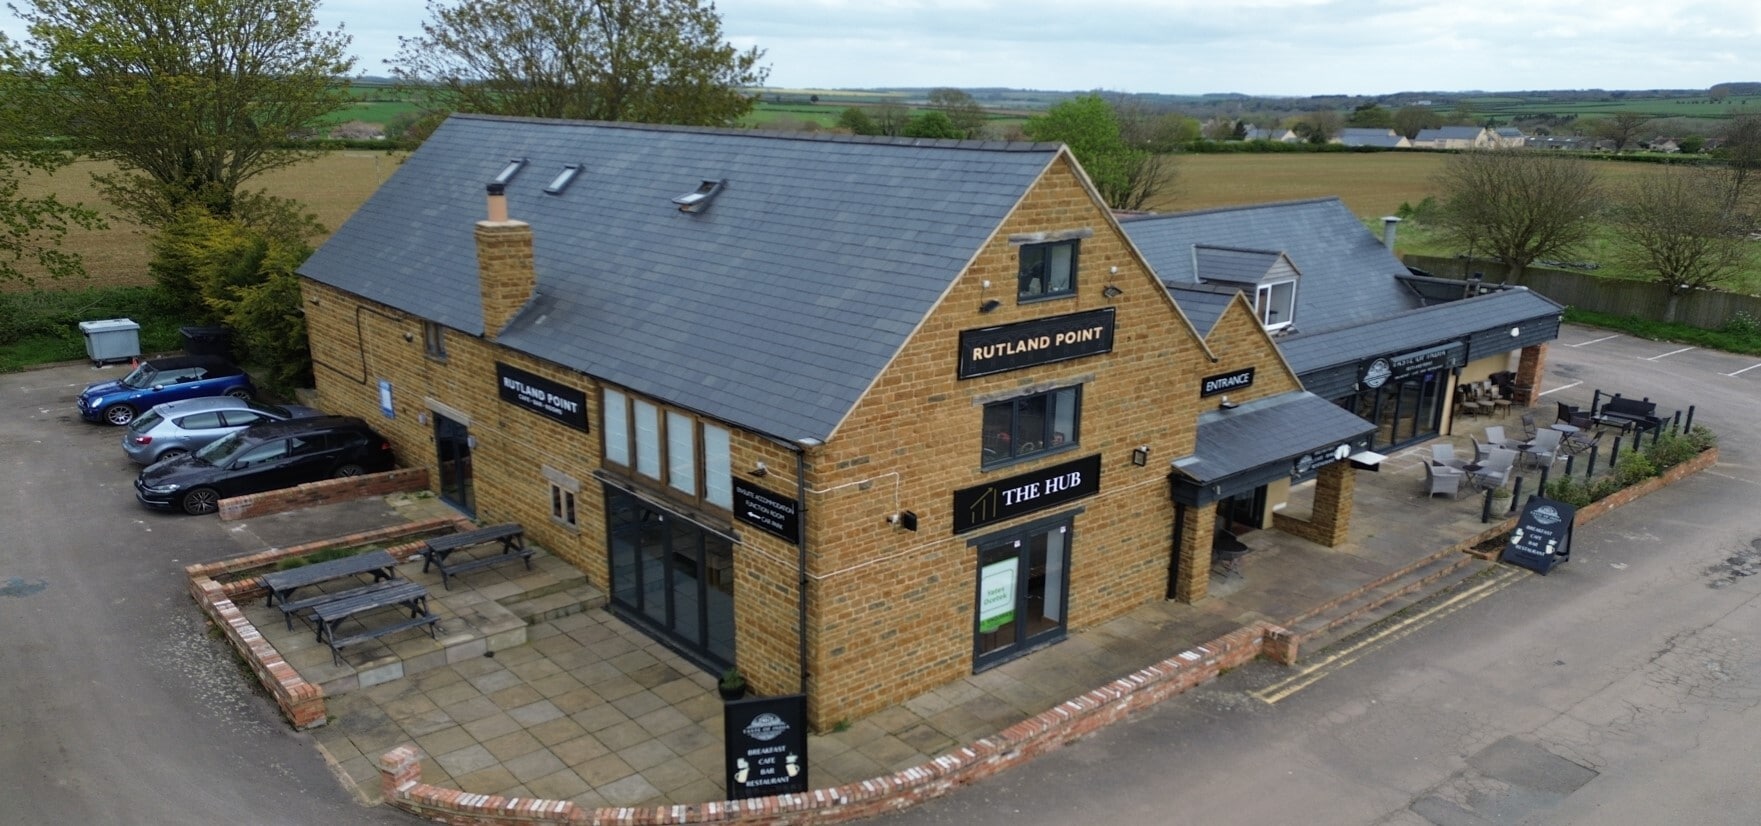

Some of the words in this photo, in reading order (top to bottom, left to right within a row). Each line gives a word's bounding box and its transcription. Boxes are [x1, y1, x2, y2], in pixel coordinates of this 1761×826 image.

[972, 336, 1050, 361] RUTLAND
[1055, 326, 1103, 346] POINT
[1206, 372, 1250, 391] ENTRANCE
[503, 376, 545, 401] RUTLAND
[547, 393, 578, 413] POINT
[1002, 482, 1040, 506] THE
[1044, 471, 1081, 495] HUB
[1526, 525, 1553, 536] BREAKFAST
[1515, 544, 1545, 556] RESTAURANT
[747, 745, 786, 756] BREAKFAST
[758, 757, 775, 765] CAFE
[760, 767, 775, 775] BAR
[746, 776, 789, 787] RESTAURANT
